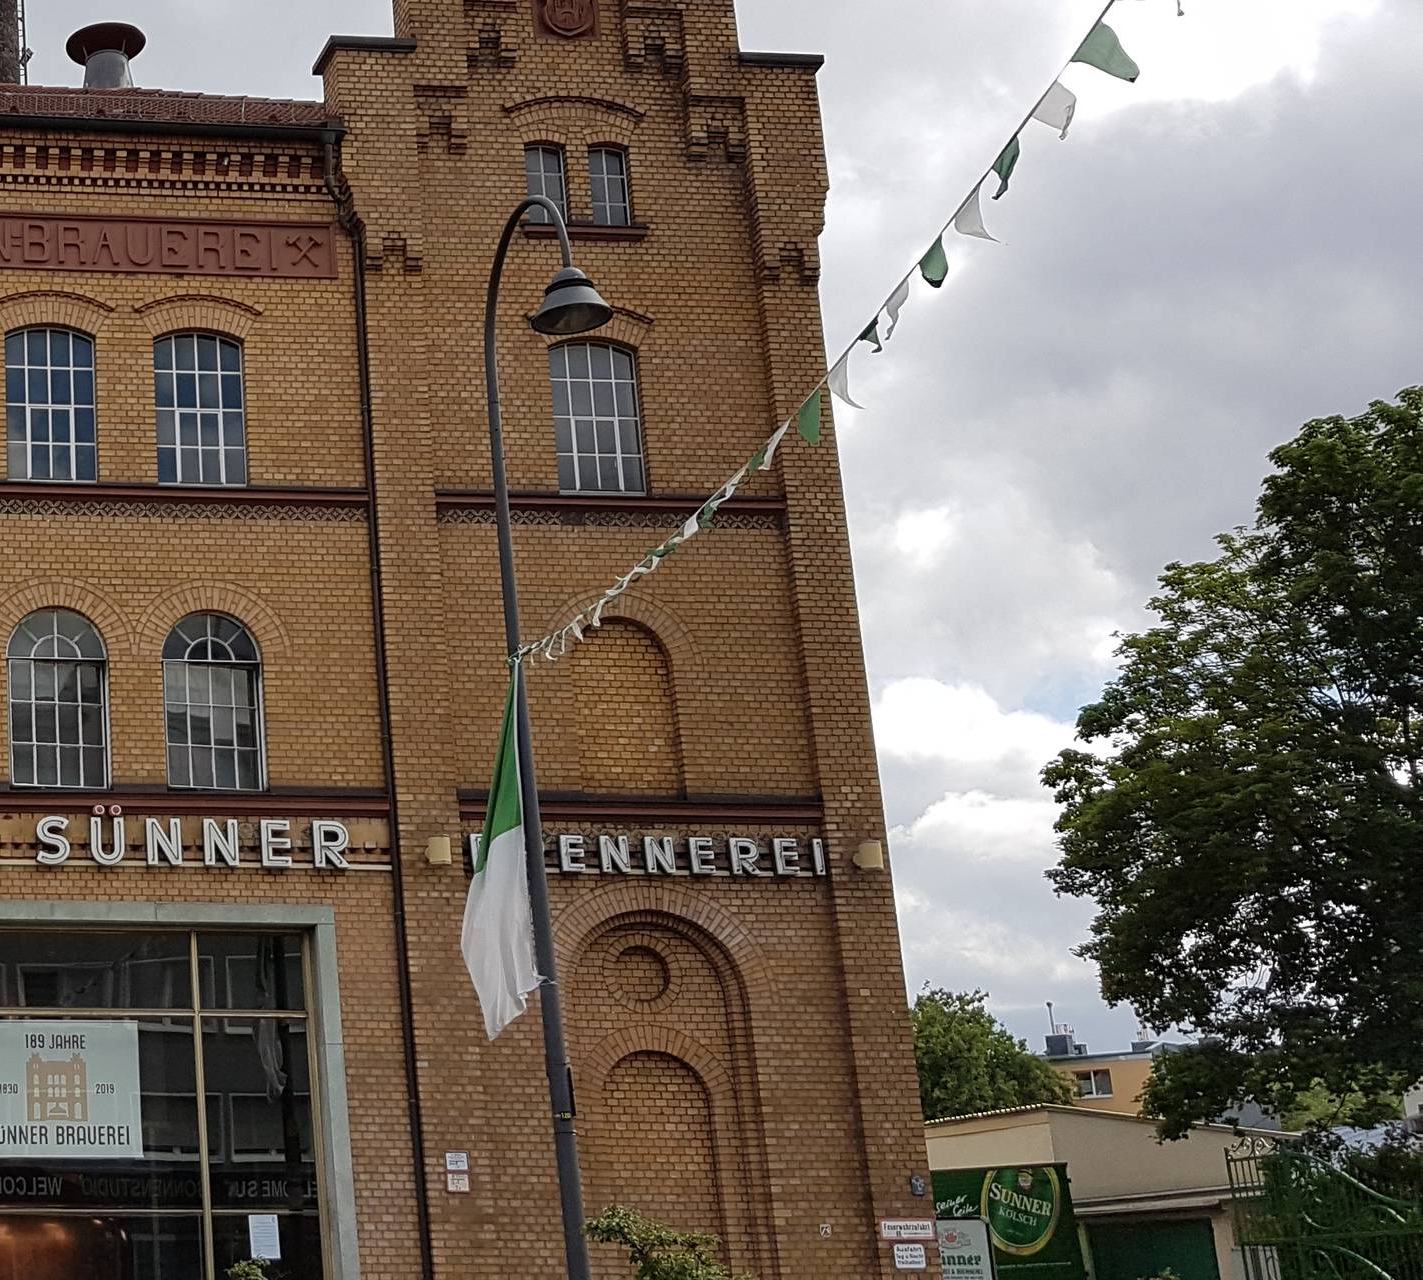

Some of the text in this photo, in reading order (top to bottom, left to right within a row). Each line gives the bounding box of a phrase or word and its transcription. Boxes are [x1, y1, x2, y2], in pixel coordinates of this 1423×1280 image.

[35, 804, 351, 870] SÜNNER
[469, 832, 828, 877] ENNEREI
[25, 1033, 87, 1050] 189 JAHRE
[95, 1083, 116, 1095] 2019
[55, 1125, 131, 1147] BRAUEREI
